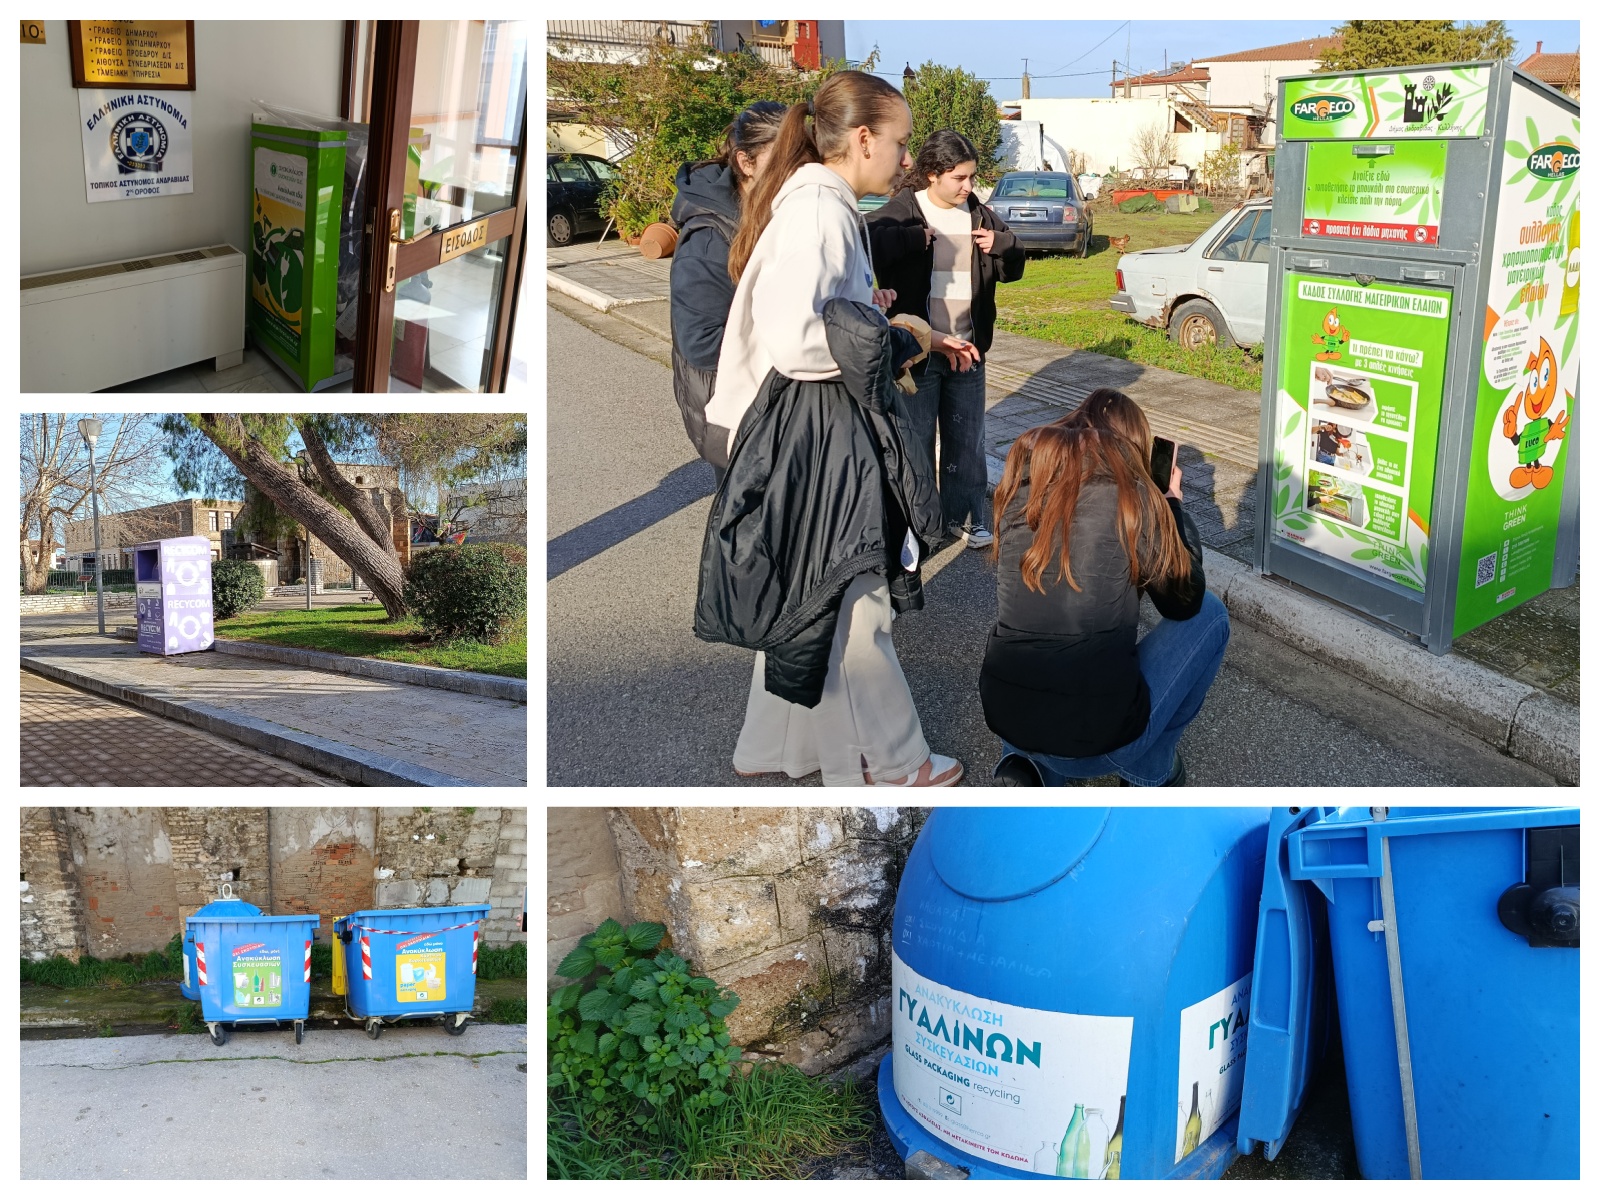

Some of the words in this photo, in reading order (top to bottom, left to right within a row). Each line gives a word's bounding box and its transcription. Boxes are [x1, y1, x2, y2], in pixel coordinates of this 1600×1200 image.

[93, 26, 121, 36] ΓΡΑΦΕΙΟ
[125, 28, 158, 38] ΔΗΜΑΡΧΟΥ
[94, 37, 122, 46] ΓΡΑΦΕΙΟ
[126, 39, 171, 49] ΑΝΤΙΔΗΜΑΡΧΟΥ
[95, 47, 122, 56] ΓΡΑΦΕΙΟ
[126, 50, 159, 59] ΠΡΟΕΔΡΟΥ
[128, 60, 172, 69] ΣΥΝΕΔΡΙΑΣΕΩΝ
[97, 68, 128, 77] ΤΑΜΕΙΑΚΗ
[132, 70, 160, 78] ΥΠΗΡΕΣΙΑ
[86, 95, 134, 131] ΕΛΛΗΝΙΚΗ
[137, 95, 187, 129] ΑΣΤΥΝΟΜΙΑ
[1404, 124, 1433, 132] Ανδραβίδας
[1438, 123, 1462, 132] Κυλλήνης
[112, 114, 134, 160] ΕΛΛΗΝΙΚΗ
[138, 114, 166, 158] ΑΣΤΥΝΟΜΙΑ
[90, 181, 117, 189] ΤΟΠΙΚΟΣ
[119, 178, 154, 187] ΑΣΤΥΝΟΜΟΣ
[156, 175, 189, 184] ΑΝΔΡΑΒΙΔΑΣ
[1352, 170, 1374, 182] Ανοίξτε
[1376, 172, 1390, 181] εδώ
[135, 187, 160, 195] ΟΡΟΦΟΣ
[1356, 183, 1383, 194] μπουκάλι
[1397, 184, 1429, 195] εσωτερικό
[1337, 194, 1358, 205] κλείστε
[1360, 195, 1372, 205] πάλι
[1546, 202, 1562, 218] κάδος
[1326, 224, 1350, 236] προσοχή
[1352, 225, 1360, 236] όχι
[1363, 224, 1380, 237] λάδια
[1381, 227, 1408, 240] μηχανής
[1520, 218, 1561, 245] συλλογής
[445, 225, 485, 255] ΕΙΣΟΔΟΣ
[1302, 284, 1325, 298] ΚΑΔΟΣ
[1328, 287, 1362, 304] ΣΥΛΛΟΓΗΣ
[1365, 292, 1410, 310] ΜΑΓΕΙΡΙΚΩΝ
[1412, 298, 1442, 314] ΕΛΑΙΩΝ
[1520, 281, 1549, 304] ελαίων
[1360, 344, 1383, 357] πρέπει
[1386, 349, 1393, 359] να
[1396, 350, 1420, 364] κάνω?
[1364, 359, 1368, 368] 3
[1504, 504, 1527, 520] THINK
[1503, 514, 1526, 531] GREEN
[1372, 549, 1400, 565] GREEN
[168, 599, 210, 609] RECYCOM
[915, 984, 1003, 1027] ΑΝΑΚΥΚΛΩΣΗ
[900, 987, 1042, 1069] ΓΥΑΛΙΝΩΝ
[915, 1031, 998, 1077] ΣΥΣΚΕΥΑΣΙΩΝ
[1219, 1057, 1236, 1074] GLASS
[905, 1044, 922, 1063] GLASS
[924, 1058, 970, 1087] PACKAGING
[973, 1082, 1021, 1105] recycling
[952, 1133, 985, 1151] ΜΕΤΑΚΙΝΕΙΤΕ
[1001, 1152, 1029, 1163] ΚΩΔΩΝΑ
